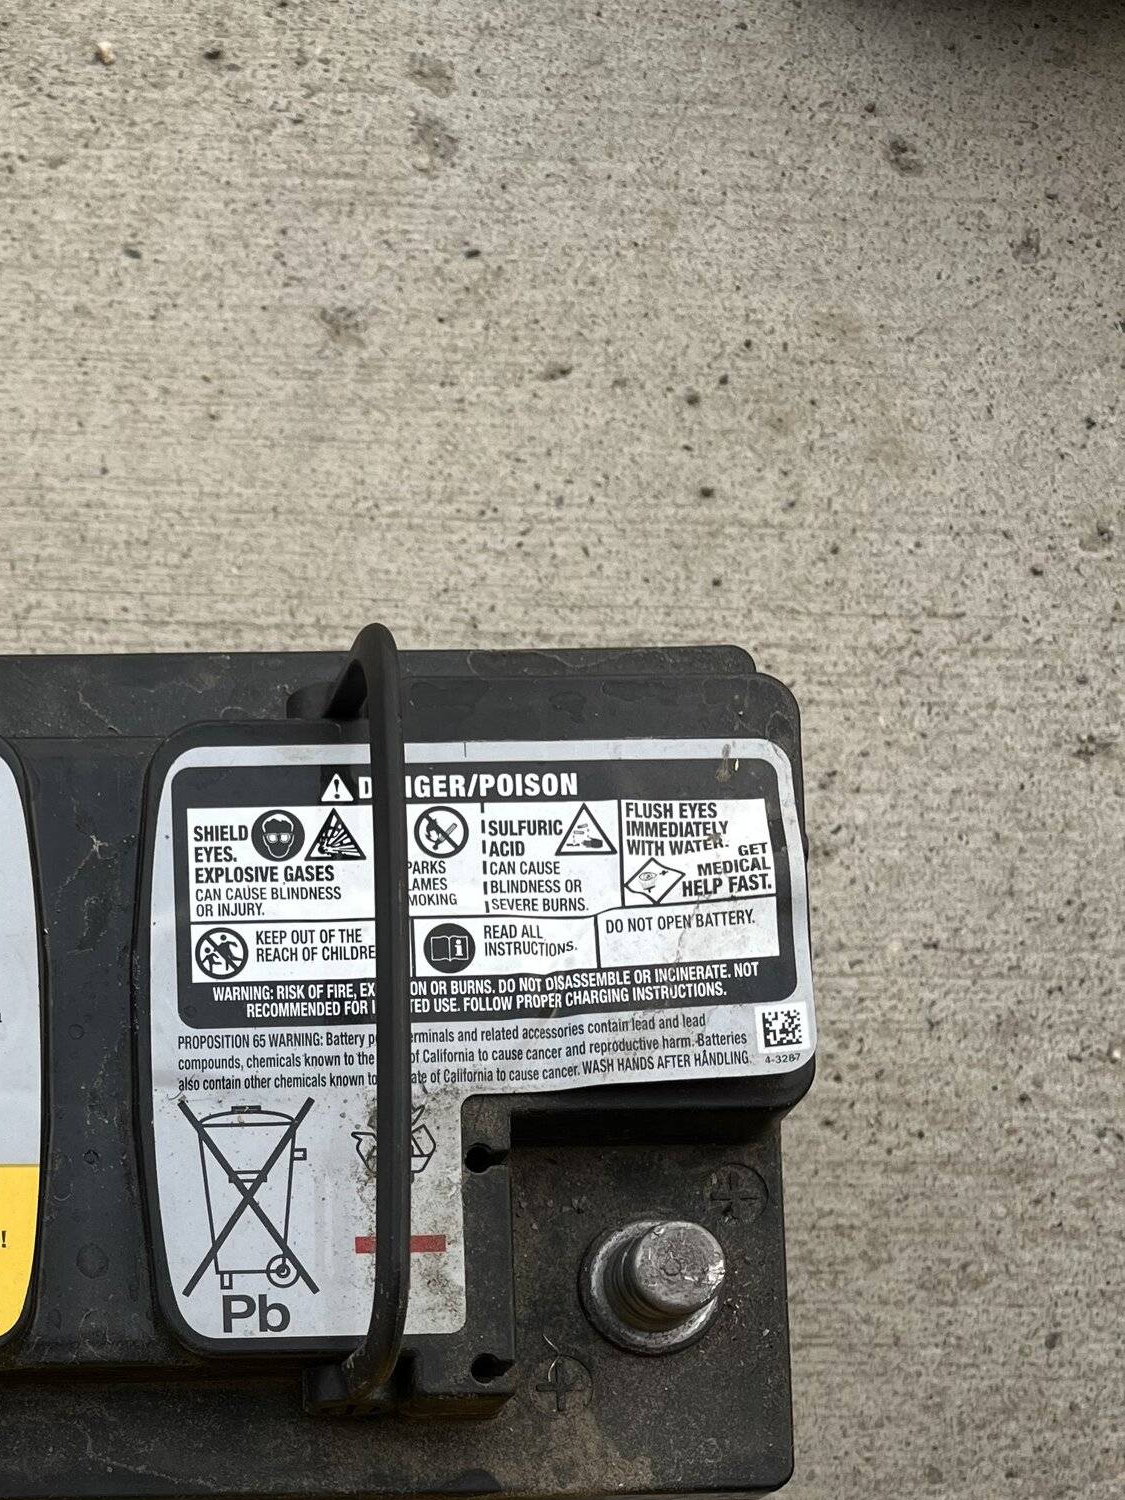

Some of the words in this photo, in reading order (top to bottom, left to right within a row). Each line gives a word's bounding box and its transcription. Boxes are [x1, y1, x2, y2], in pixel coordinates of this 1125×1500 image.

[625, 802, 673, 819] FLUSH
[679, 802, 717, 819] EYES
[194, 825, 248, 842] SHIELD
[488, 819, 563, 836] SULFURIC
[626, 820, 728, 838] IMMEDIATELY
[194, 846, 237, 863] EYES.
[489, 841, 525, 857] ACID
[626, 839, 664, 856] WITH
[669, 840, 729, 856] WATER.
[738, 842, 768, 856] GET
[195, 866, 279, 884] EXPLOSIVE
[284, 865, 334, 882] GASES
[490, 861, 516, 875] CAN
[520, 861, 560, 875] CAUSE
[697, 856, 771, 876] MEDICAL
[490, 879, 561, 894] BLINDNESS
[565, 879, 582, 893] OR
[682, 877, 723, 897] HELP
[728, 873, 772, 893] FAST.
[491, 898, 539, 912] SEVERE
[542, 897, 589, 912] BURNS.
[606, 919, 623, 934] DO
[627, 917, 653, 932] NOT
[657, 914, 694, 930] OPEN
[695, 908, 755, 928] BATTERY.
[484, 924, 517, 939] READ
[521, 924, 543, 939] ALL
[485, 941, 577, 957] INSTRUCTIONS.
[213, 985, 273, 1001] WARNING:
[276, 985, 305, 1000] RISK
[178, 1034, 249, 1049] PROPOSITION
[253, 1034, 266, 1048] 65
[268, 1032, 323, 1048] WARNING:
[222, 1294, 290, 1333] Pb
